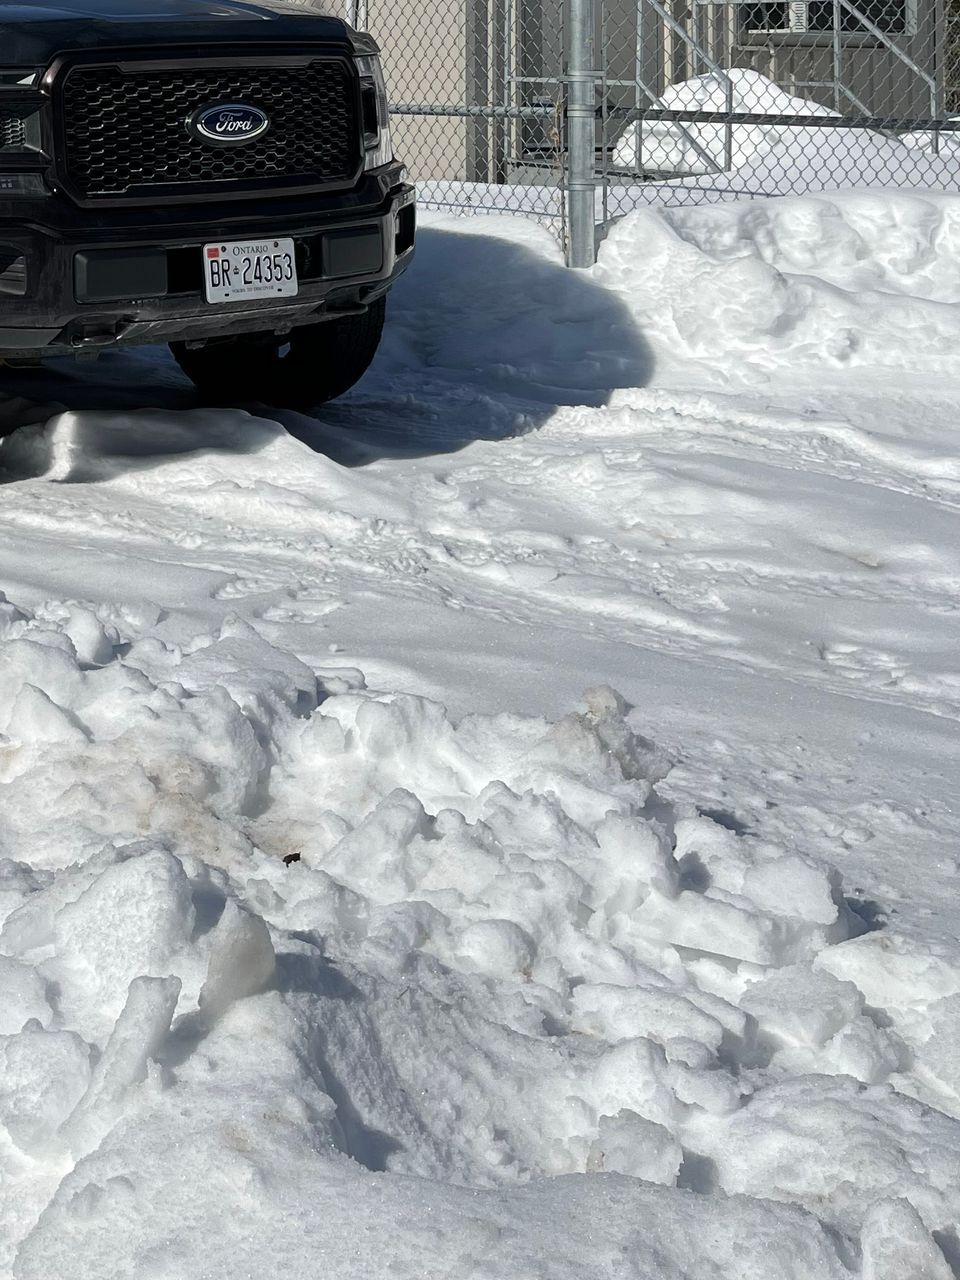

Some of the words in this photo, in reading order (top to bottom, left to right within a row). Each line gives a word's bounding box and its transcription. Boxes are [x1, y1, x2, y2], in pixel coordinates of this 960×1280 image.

[215, 111, 253, 132] Ford
[232, 245, 269, 257] ONTARIO
[209, 259, 232, 288] BR
[242, 253, 293, 285] 24353
